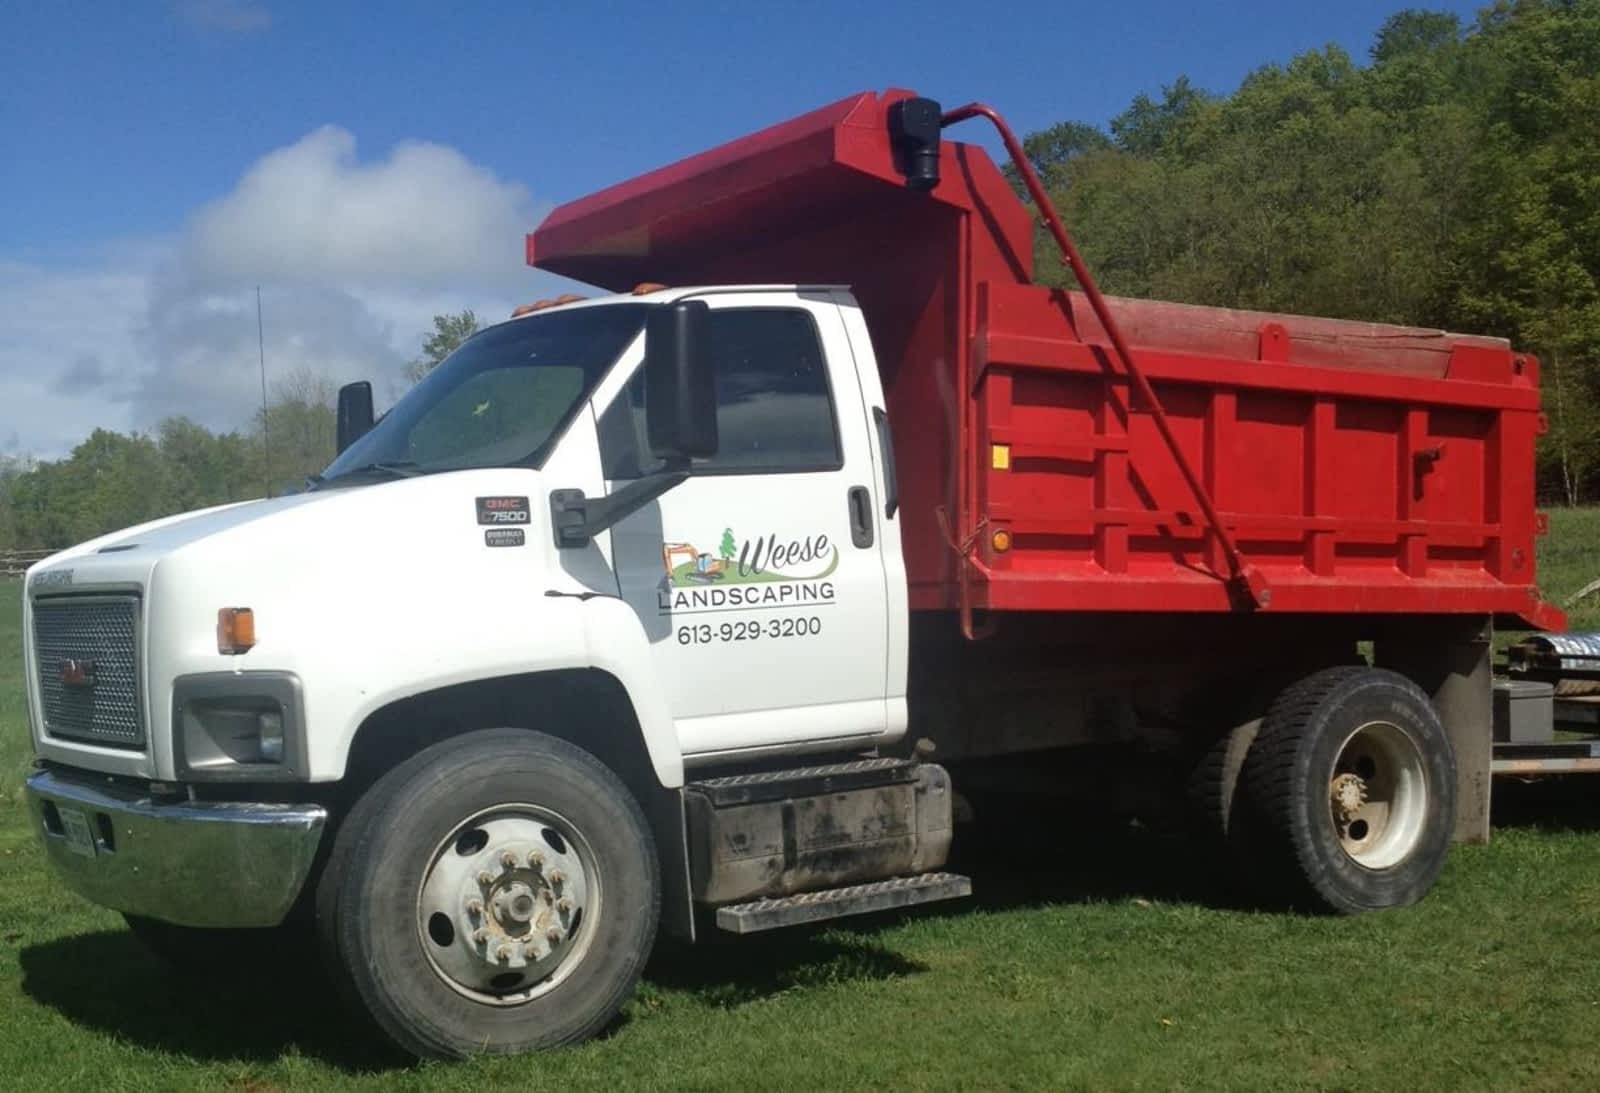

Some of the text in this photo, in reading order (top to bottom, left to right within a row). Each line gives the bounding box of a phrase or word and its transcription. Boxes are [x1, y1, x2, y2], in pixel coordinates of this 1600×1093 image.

[738, 533, 830, 577] Weese
[658, 582, 836, 609] LANDSCAPING
[678, 617, 821, 645] 613-929-3200
